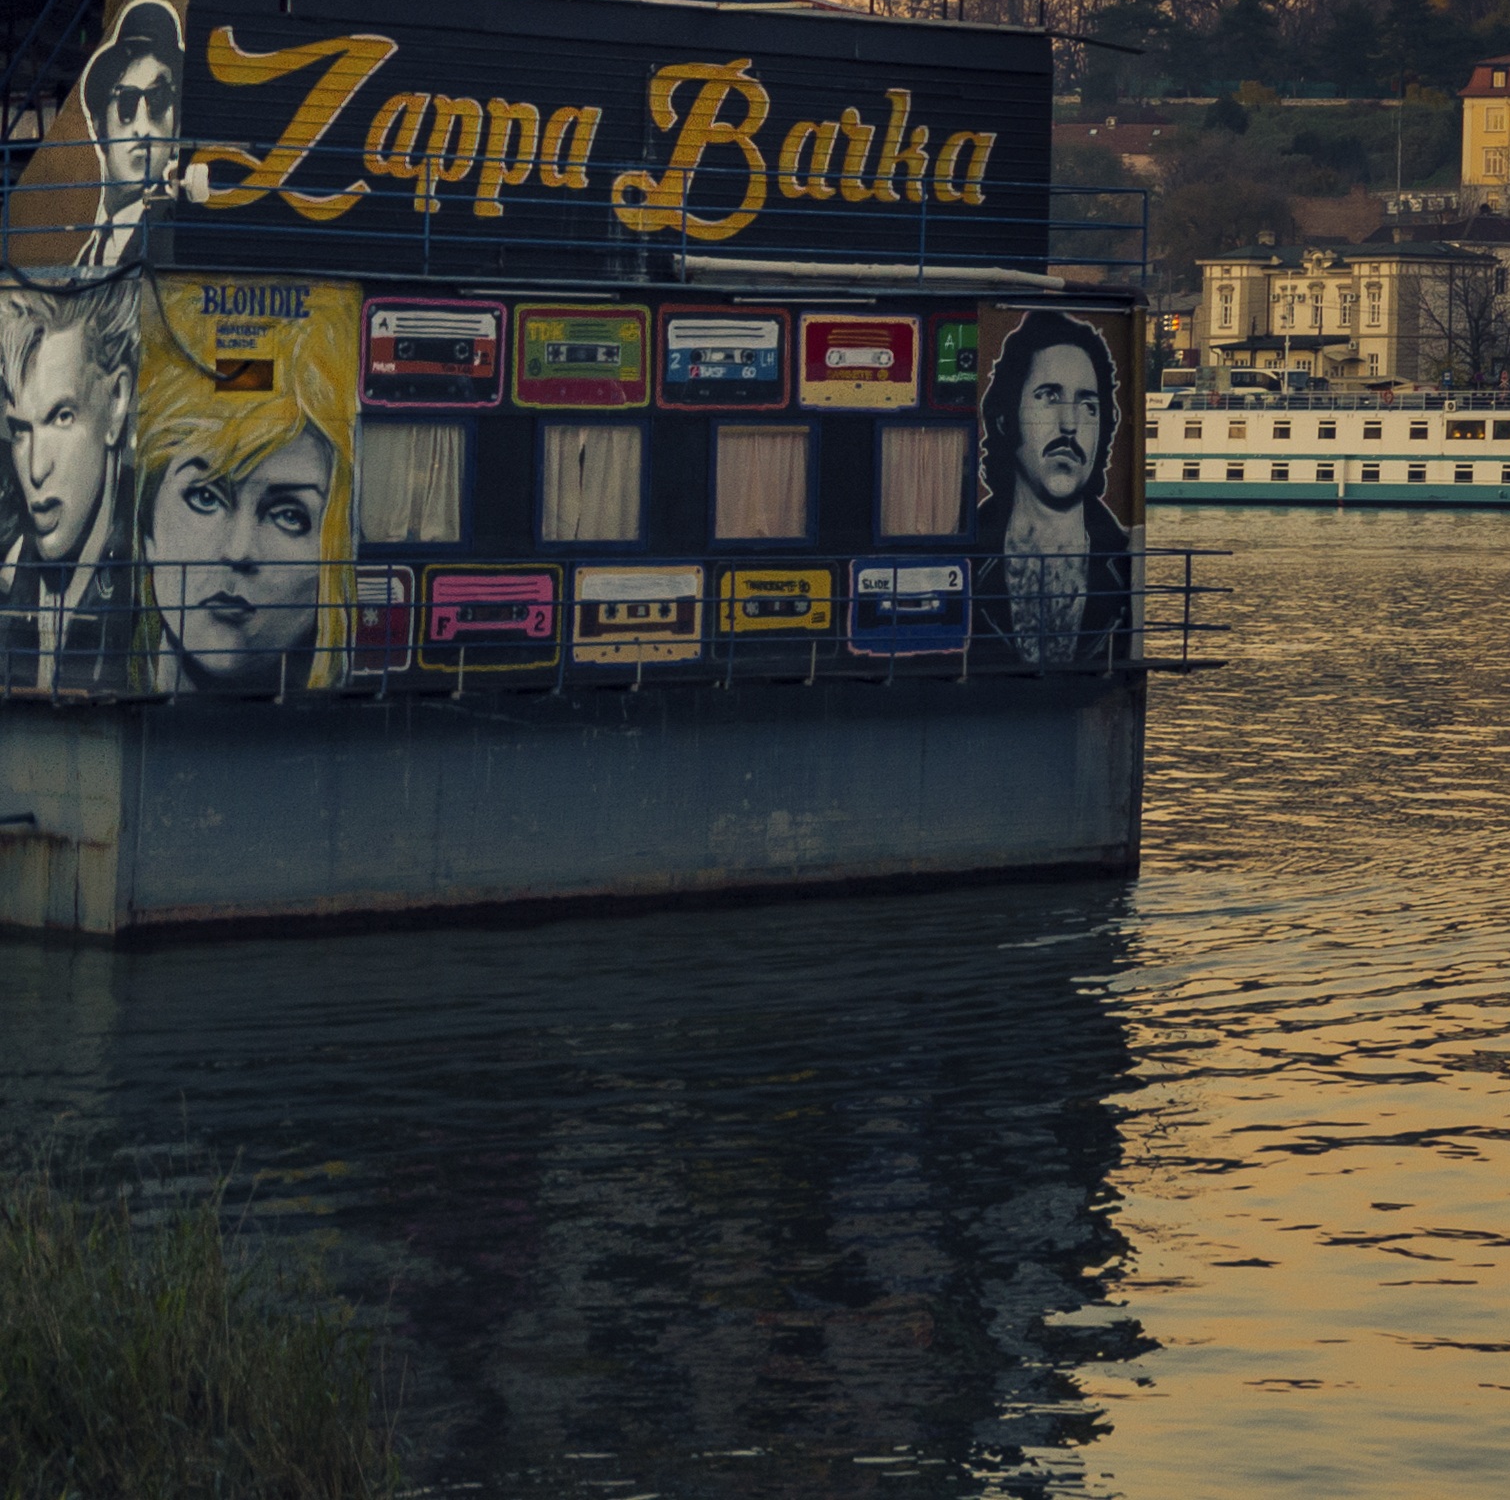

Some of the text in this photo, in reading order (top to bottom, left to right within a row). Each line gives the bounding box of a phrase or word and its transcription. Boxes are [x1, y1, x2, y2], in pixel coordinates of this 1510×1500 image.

[191, 25, 998, 241] Zappa Barka
[201, 284, 311, 318] BLONDIE
[379, 317, 389, 331] A
[944, 333, 955, 349] A
[671, 353, 681, 370] 2
[700, 366, 757, 379] BASF 60
[862, 579, 890, 590] SLIDE
[948, 570, 958, 587] 2
[436, 616, 451, 636] F
[534, 611, 546, 631] 2
